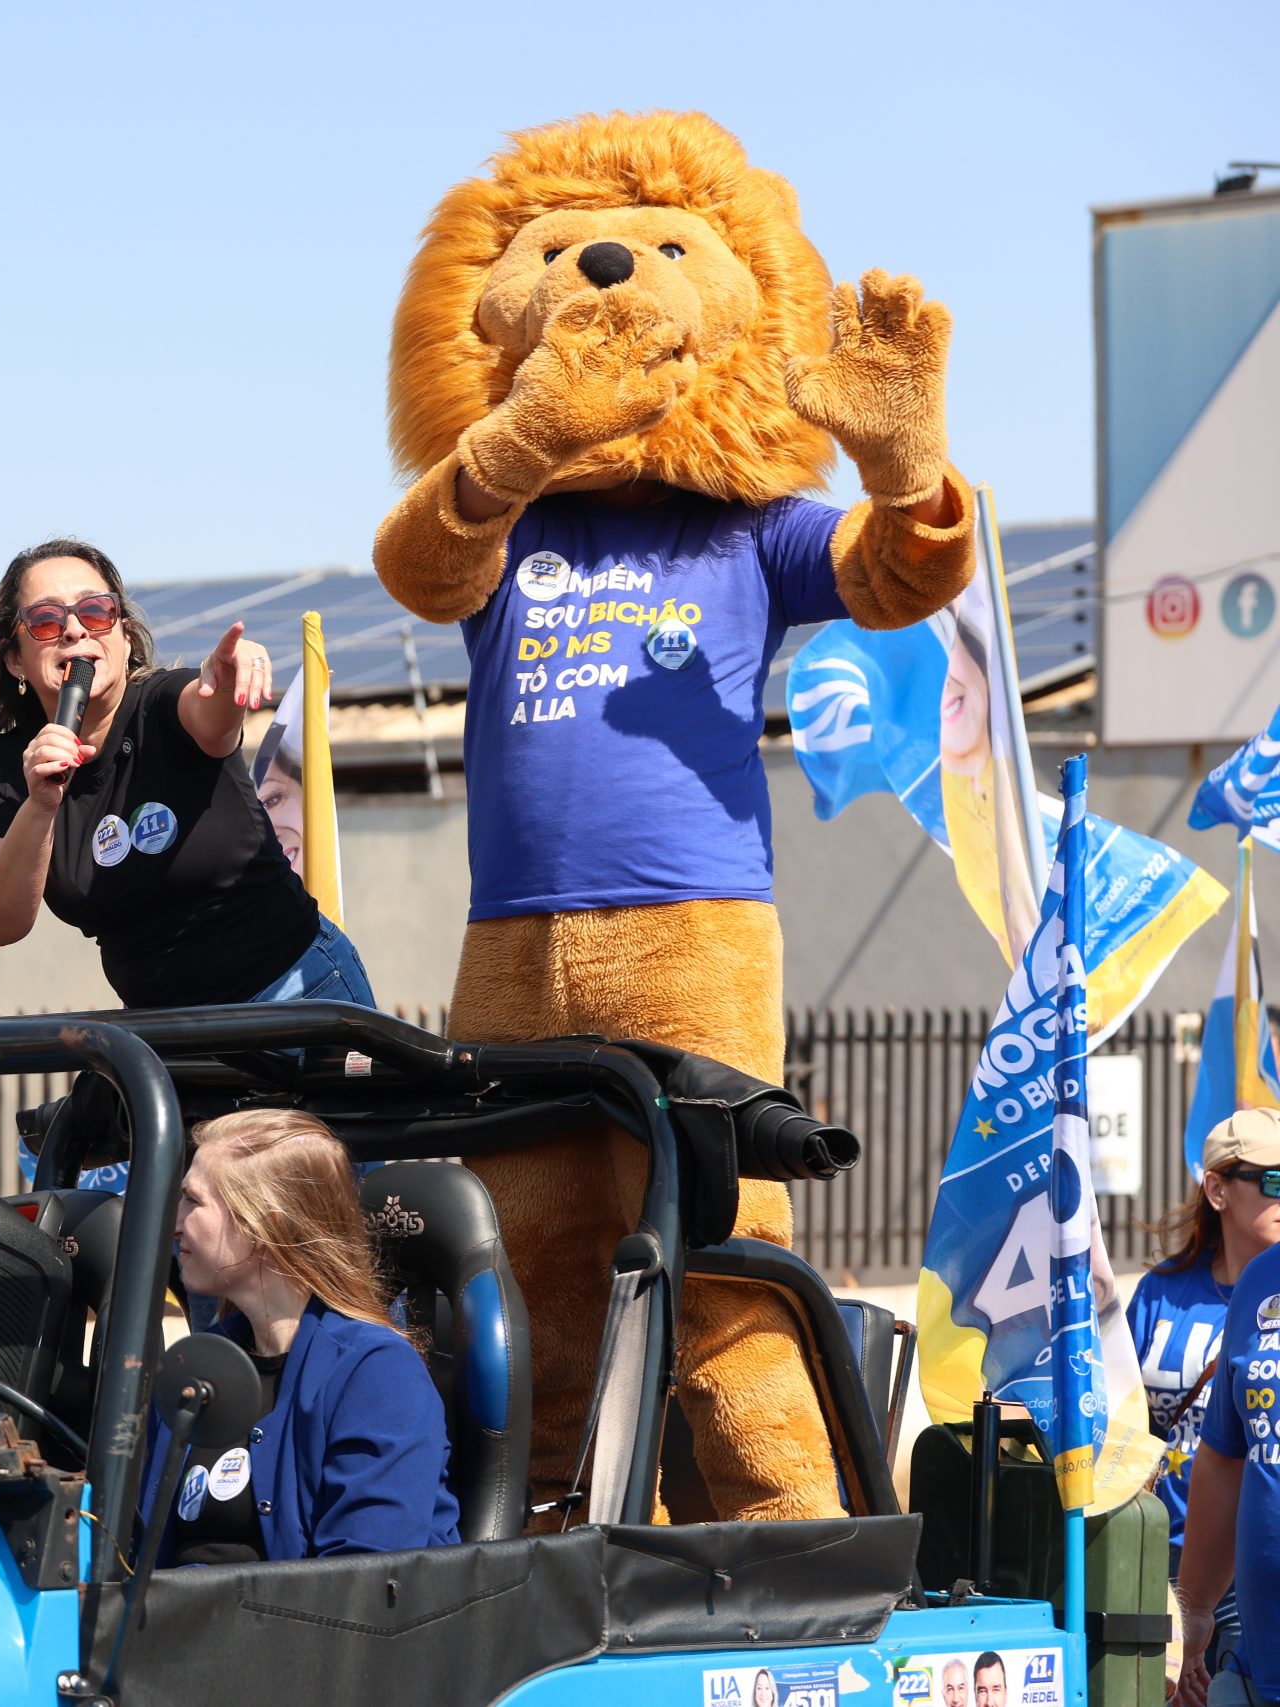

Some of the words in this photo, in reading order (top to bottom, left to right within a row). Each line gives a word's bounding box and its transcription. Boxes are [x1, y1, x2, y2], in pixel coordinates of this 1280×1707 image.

[531, 561, 558, 575] 222
[568, 564, 653, 598] MBÉM
[525, 605, 586, 629] SOU
[588, 598, 702, 627] BICHÃO
[518, 637, 559, 661] DO
[566, 631, 612, 658] MS
[517, 664, 548, 694] TÔ
[555, 664, 628, 688] COM
[510, 701, 527, 725] A
[532, 696, 576, 722] LIA
[99, 827, 115, 841] 222
[972, 1007, 1056, 1101] NOG
[1006, 1153, 1051, 1192] DEP
[1246, 1388, 1275, 1410] DO
[1249, 1412, 1271, 1438] TÔ
[222, 1459, 240, 1470] 222
[710, 1675, 741, 1699] LIA
[899, 1674, 929, 1694] 222
[1022, 1690, 1058, 1704] RIEDEL
